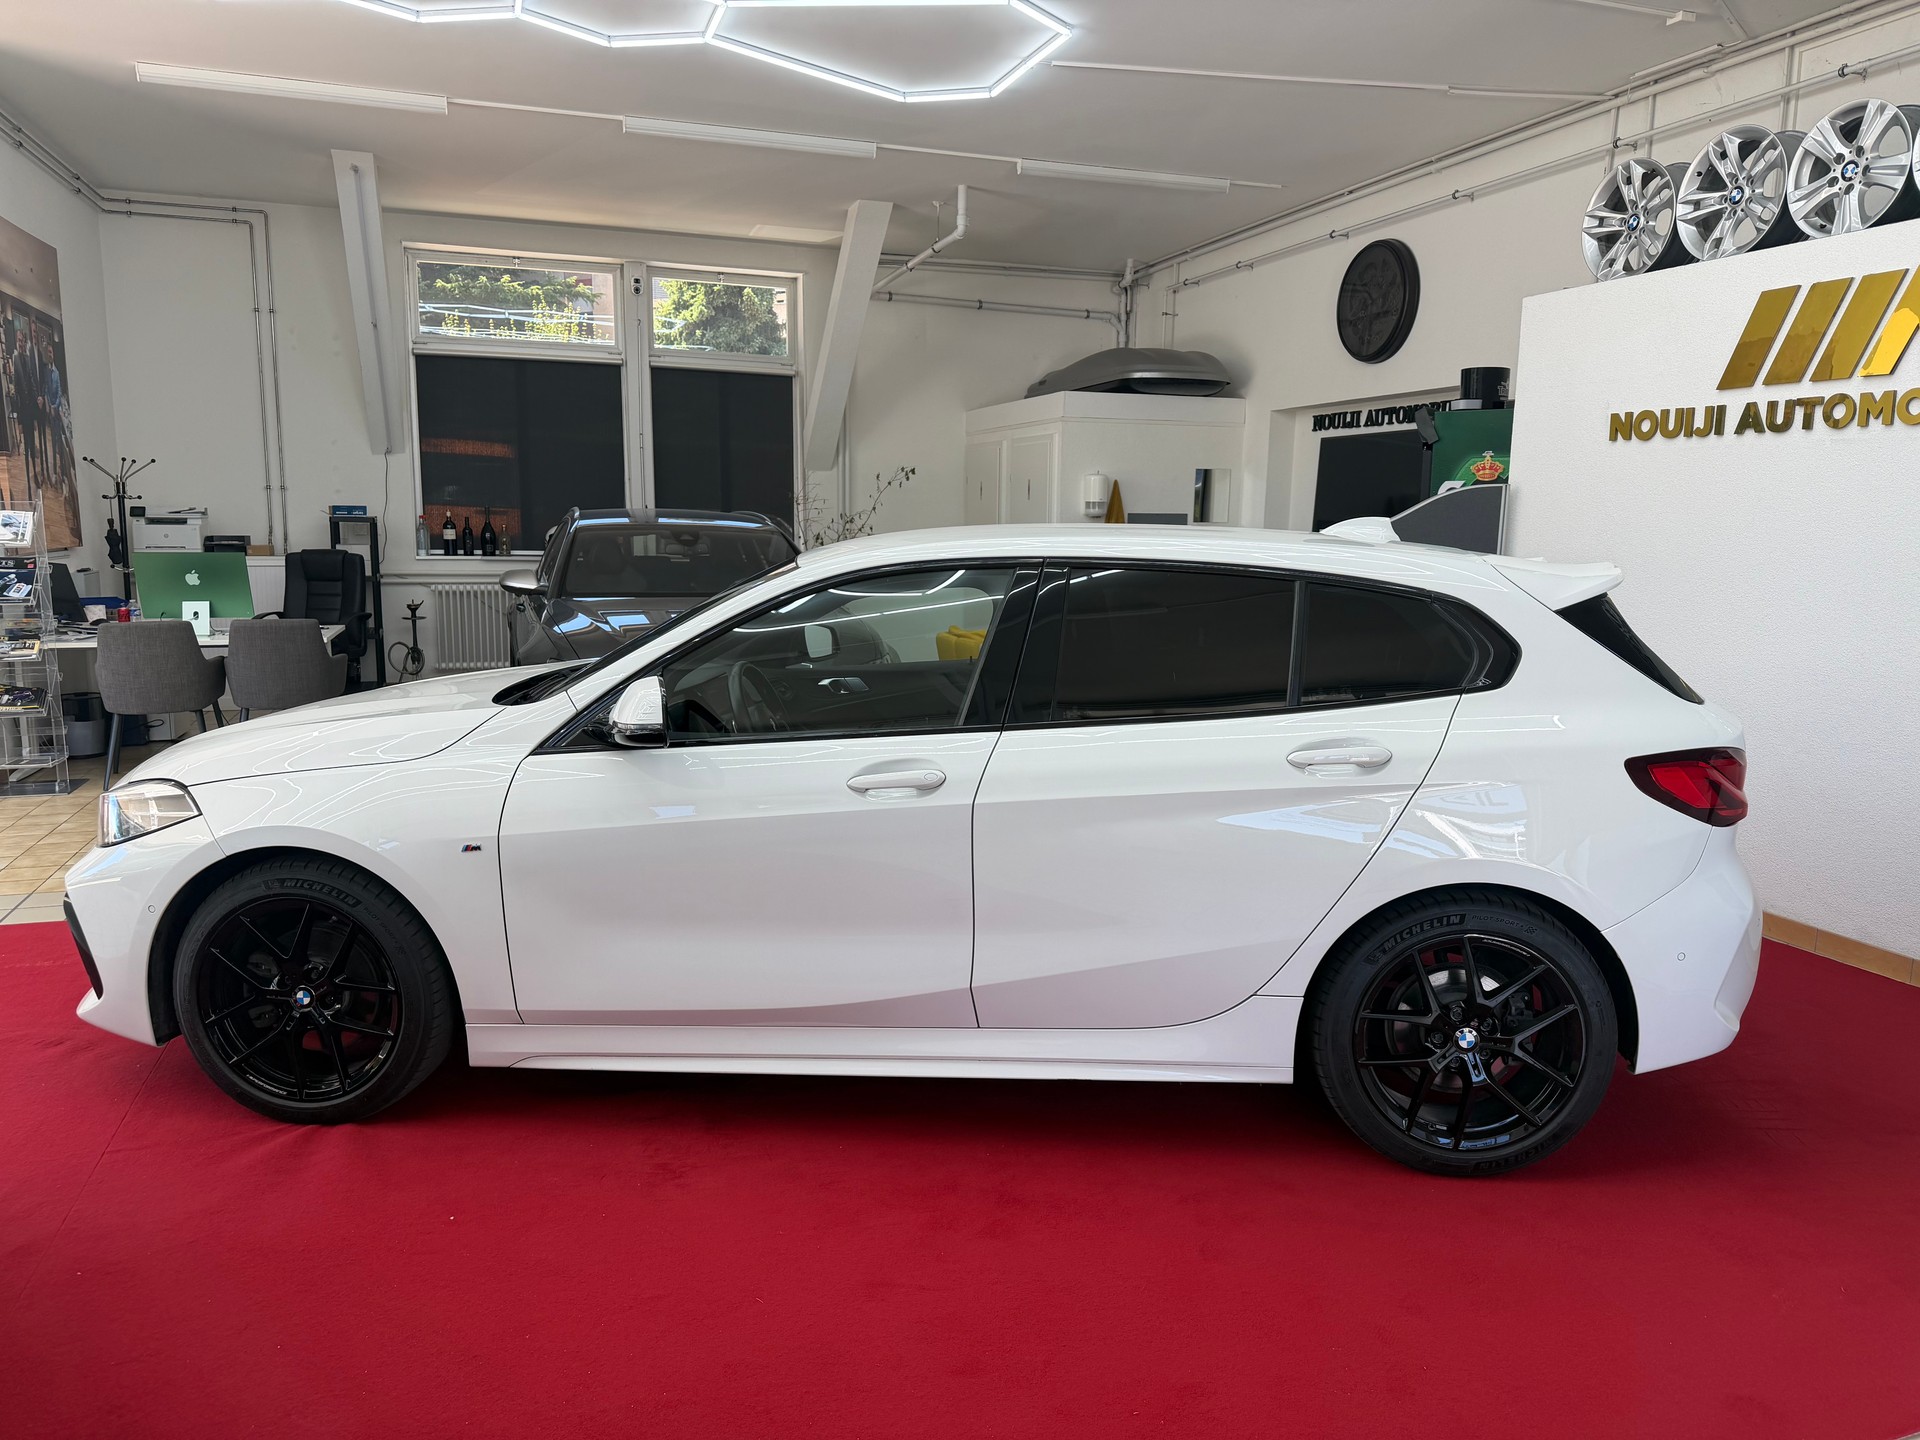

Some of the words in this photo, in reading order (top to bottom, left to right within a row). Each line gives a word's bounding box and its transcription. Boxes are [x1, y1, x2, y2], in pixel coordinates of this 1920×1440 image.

[1312, 410, 1363, 432] NOUIJI
[1609, 404, 1727, 442] NOUIJI
[1733, 387, 1920, 435] AUTOMO
[283, 879, 358, 906] MICHELIN
[1383, 914, 1462, 951] MICHELIN
[1494, 917, 1520, 927] SPORT
